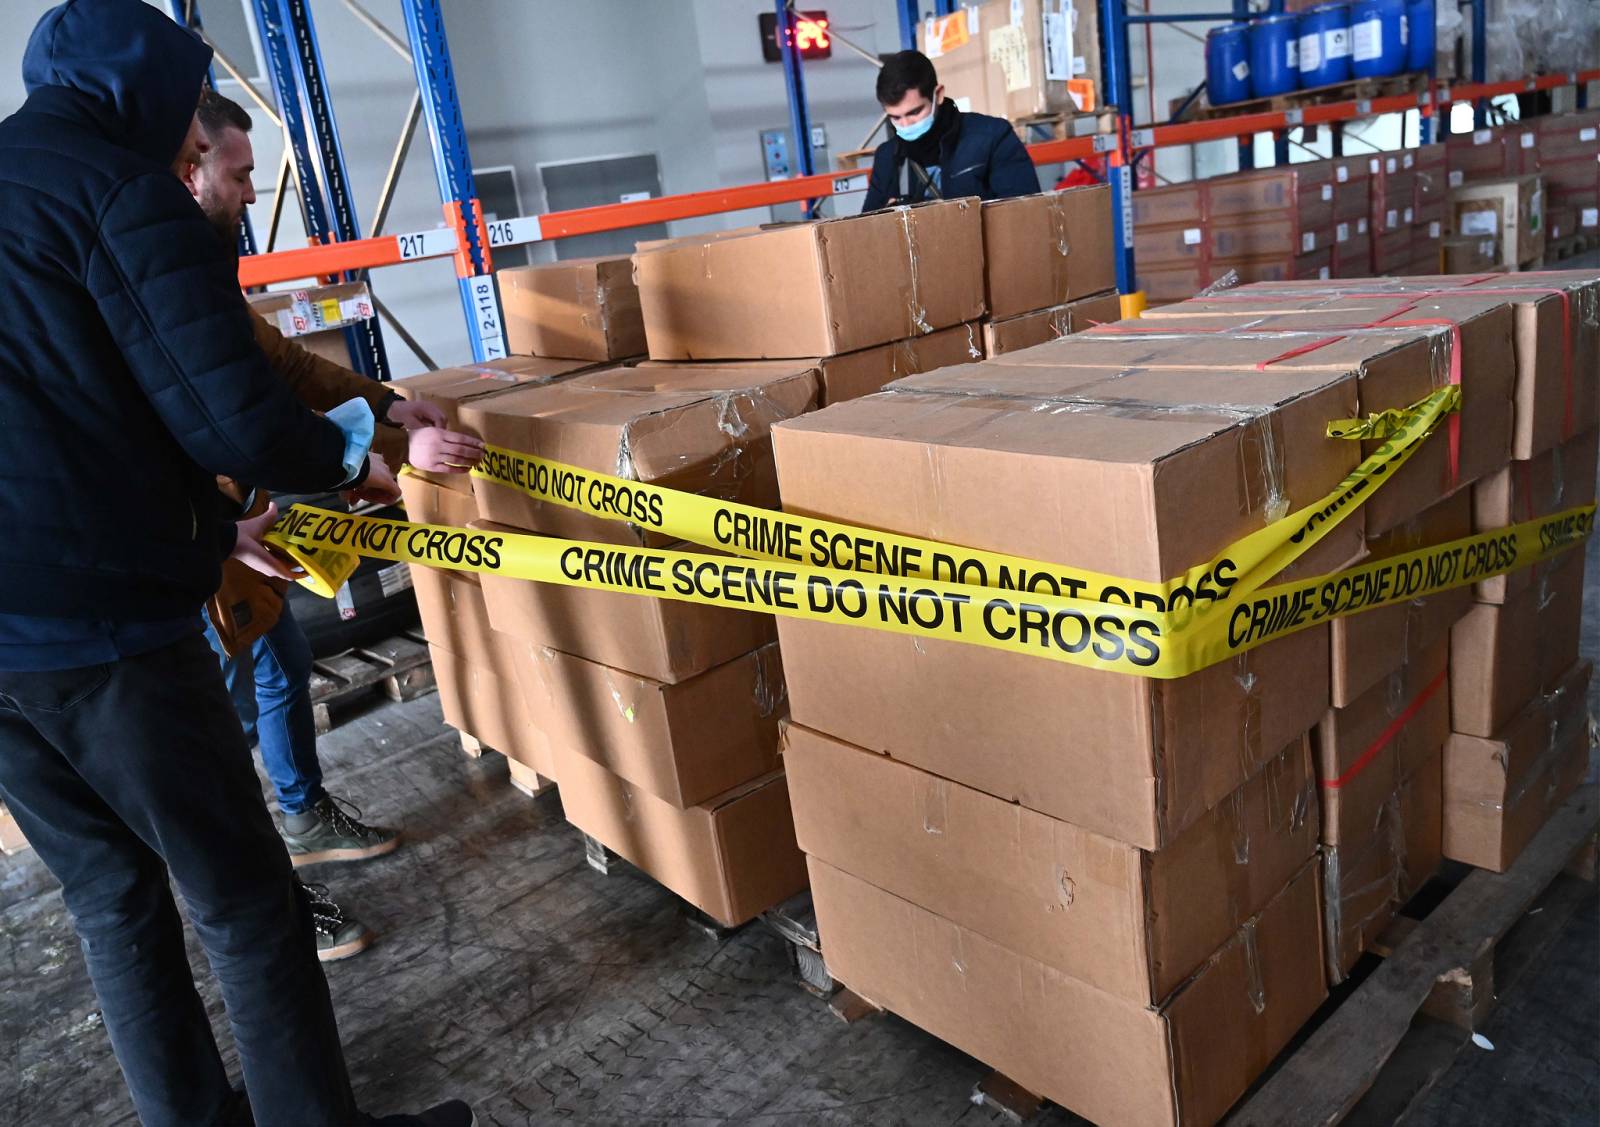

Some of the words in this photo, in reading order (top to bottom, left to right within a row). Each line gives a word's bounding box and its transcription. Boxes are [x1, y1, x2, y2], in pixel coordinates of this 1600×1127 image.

[400, 234, 425, 258] 217
[489, 222, 514, 245] 216
[477, 284, 496, 330] 2-118
[528, 462, 549, 495] DO
[552, 469, 586, 505] NOT
[588, 479, 664, 527] CROSS
[312, 516, 354, 545] DO
[352, 521, 410, 553] NOT
[408, 527, 503, 570] CROSS
[713, 508, 803, 562] CRIME
[809, 528, 923, 577] SCENE
[932, 552, 988, 587] DO
[560, 546, 666, 592] CRIME
[672, 558, 798, 610] SCENE
[807, 575, 867, 618] DO
[879, 584, 970, 633] NOT
[983, 598, 1161, 667] CROSS
[1228, 586, 1316, 649] CRIME
[1319, 569, 1393, 624] SCENE
[1393, 558, 1424, 601] DO
[1424, 549, 1464, 589] NOT
[1463, 535, 1519, 581] CROSS
